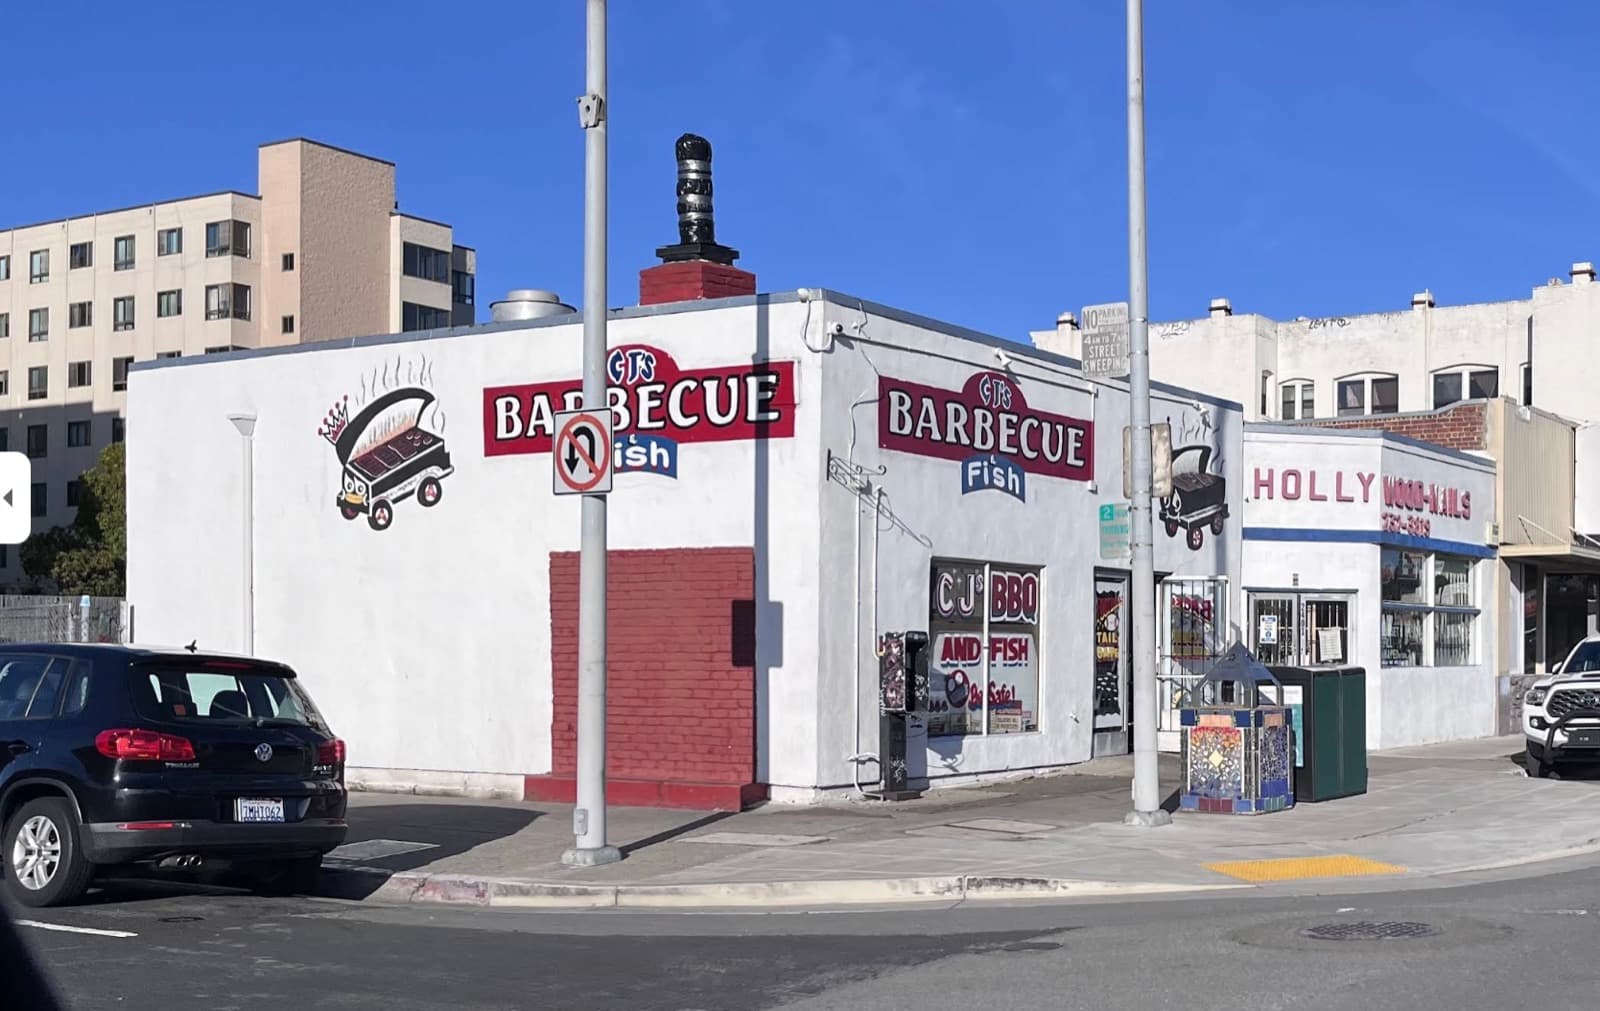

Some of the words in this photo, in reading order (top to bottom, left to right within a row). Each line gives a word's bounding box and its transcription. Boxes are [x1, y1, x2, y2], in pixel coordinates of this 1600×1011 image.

[1083, 310, 1098, 329] NO
[1084, 358, 1128, 373] SWEEPING
[1088, 344, 1120, 358] STREET
[888, 390, 1085, 467] BARBECUE
[613, 441, 670, 469] ish
[967, 461, 1020, 495] Fish
[1254, 467, 1375, 503] HOLLY
[1103, 505, 1111, 519] 2
[990, 571, 1038, 625] BBQ
[941, 636, 982, 666] AND
[991, 637, 1028, 666] FISH
